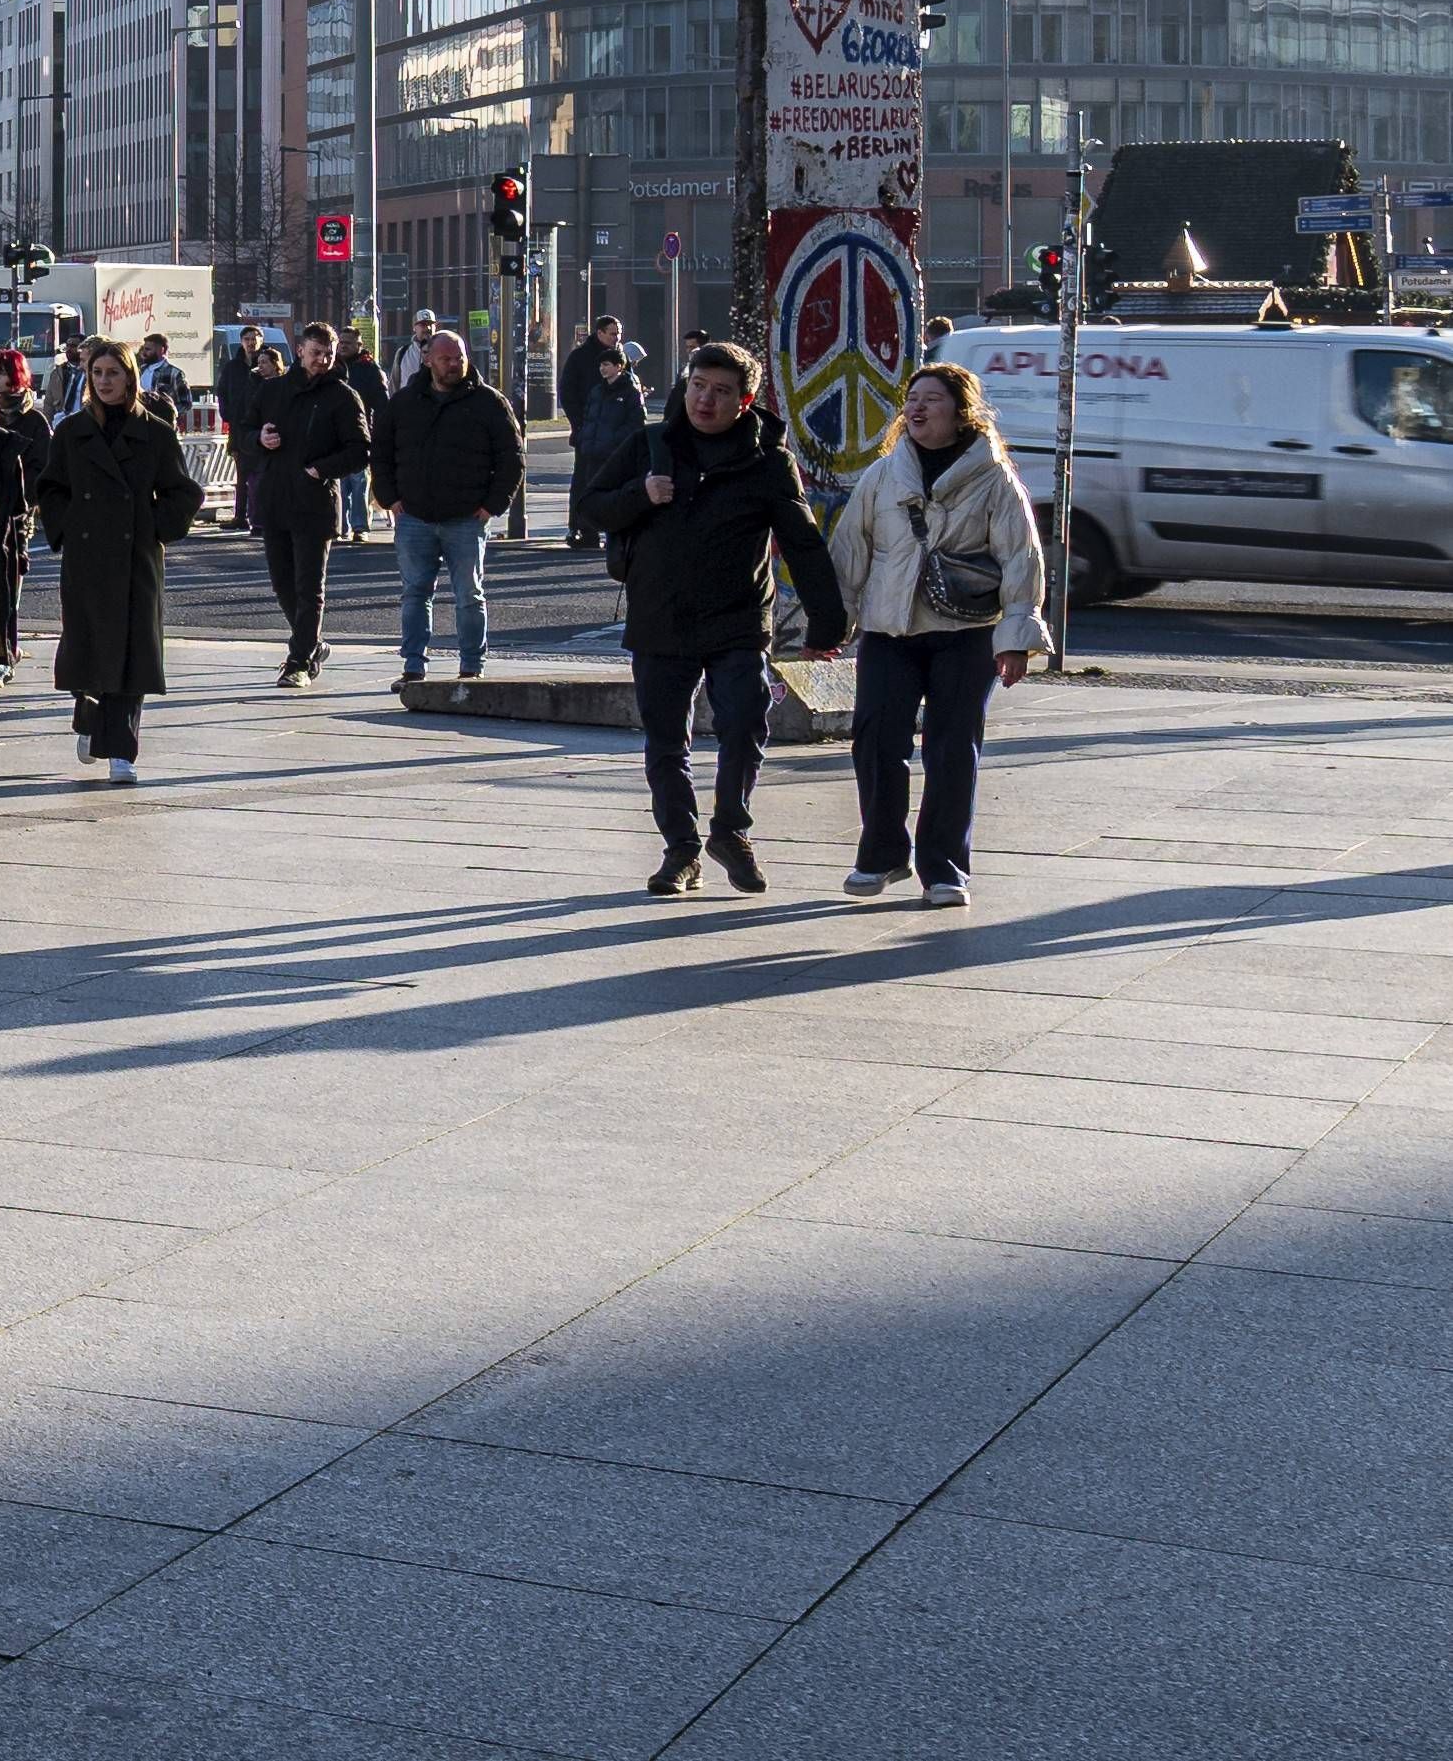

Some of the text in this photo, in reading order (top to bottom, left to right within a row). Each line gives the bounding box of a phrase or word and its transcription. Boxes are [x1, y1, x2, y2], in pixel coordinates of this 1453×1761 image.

[769, 105, 919, 133] #FREEDOMBELARUS
[102, 288, 156, 332] Haberling
[983, 351, 1171, 380] APLONA
